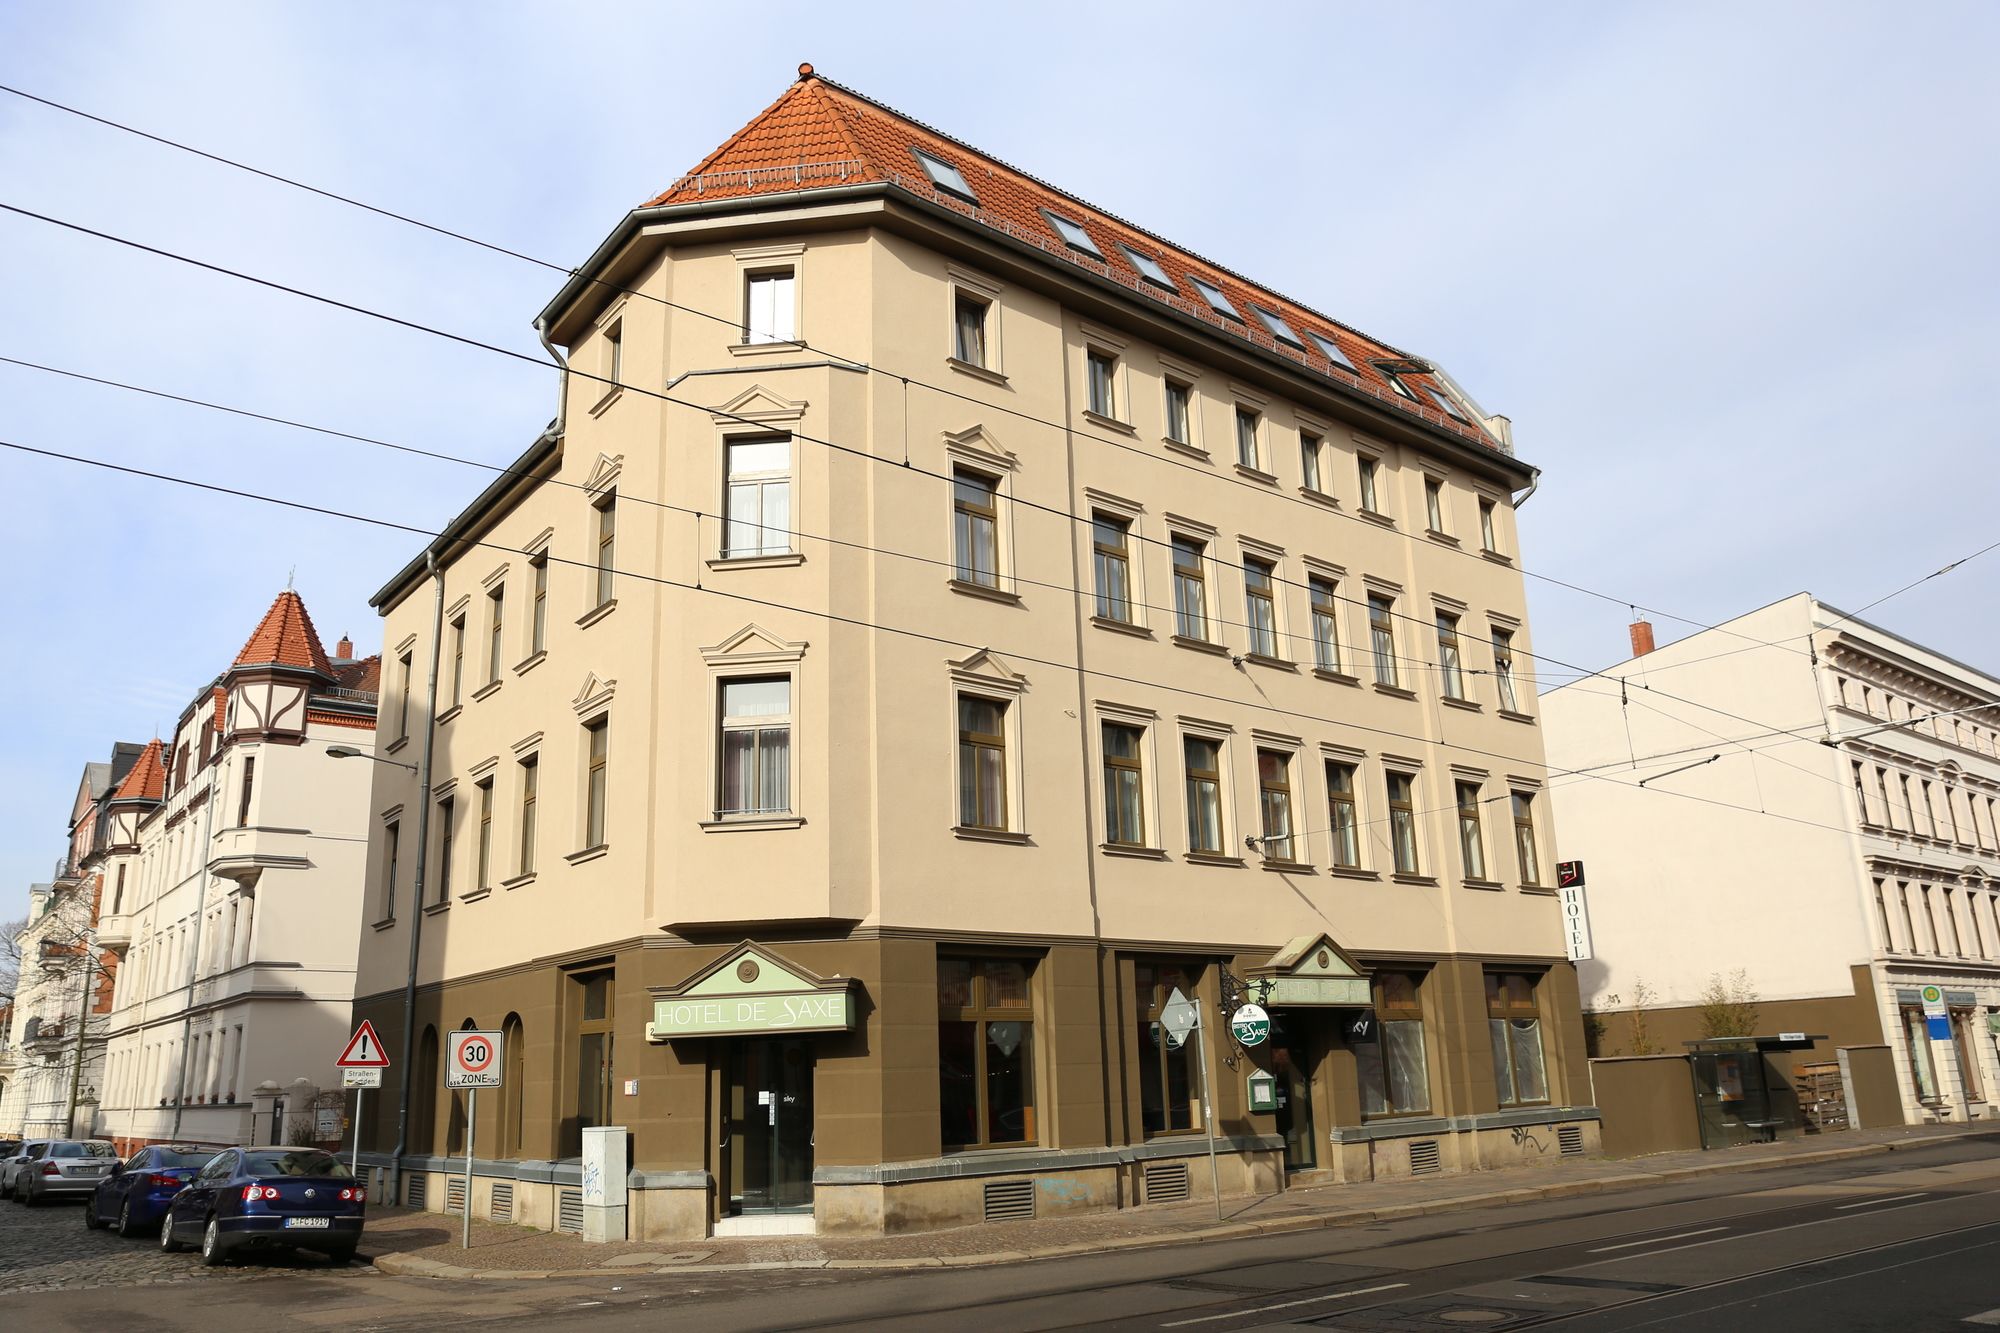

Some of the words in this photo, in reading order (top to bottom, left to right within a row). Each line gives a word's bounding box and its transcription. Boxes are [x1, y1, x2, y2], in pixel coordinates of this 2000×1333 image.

[1565, 889, 1584, 959] HOTEL
[658, 1004, 730, 1025] HOTEL
[737, 1002, 767, 1022] DE
[768, 996, 841, 1026] SAXE
[1241, 1022, 1267, 1041] SAXE
[465, 1045, 486, 1062] 30
[461, 1074, 488, 1084] ZONE
[783, 1095, 796, 1103] sky
